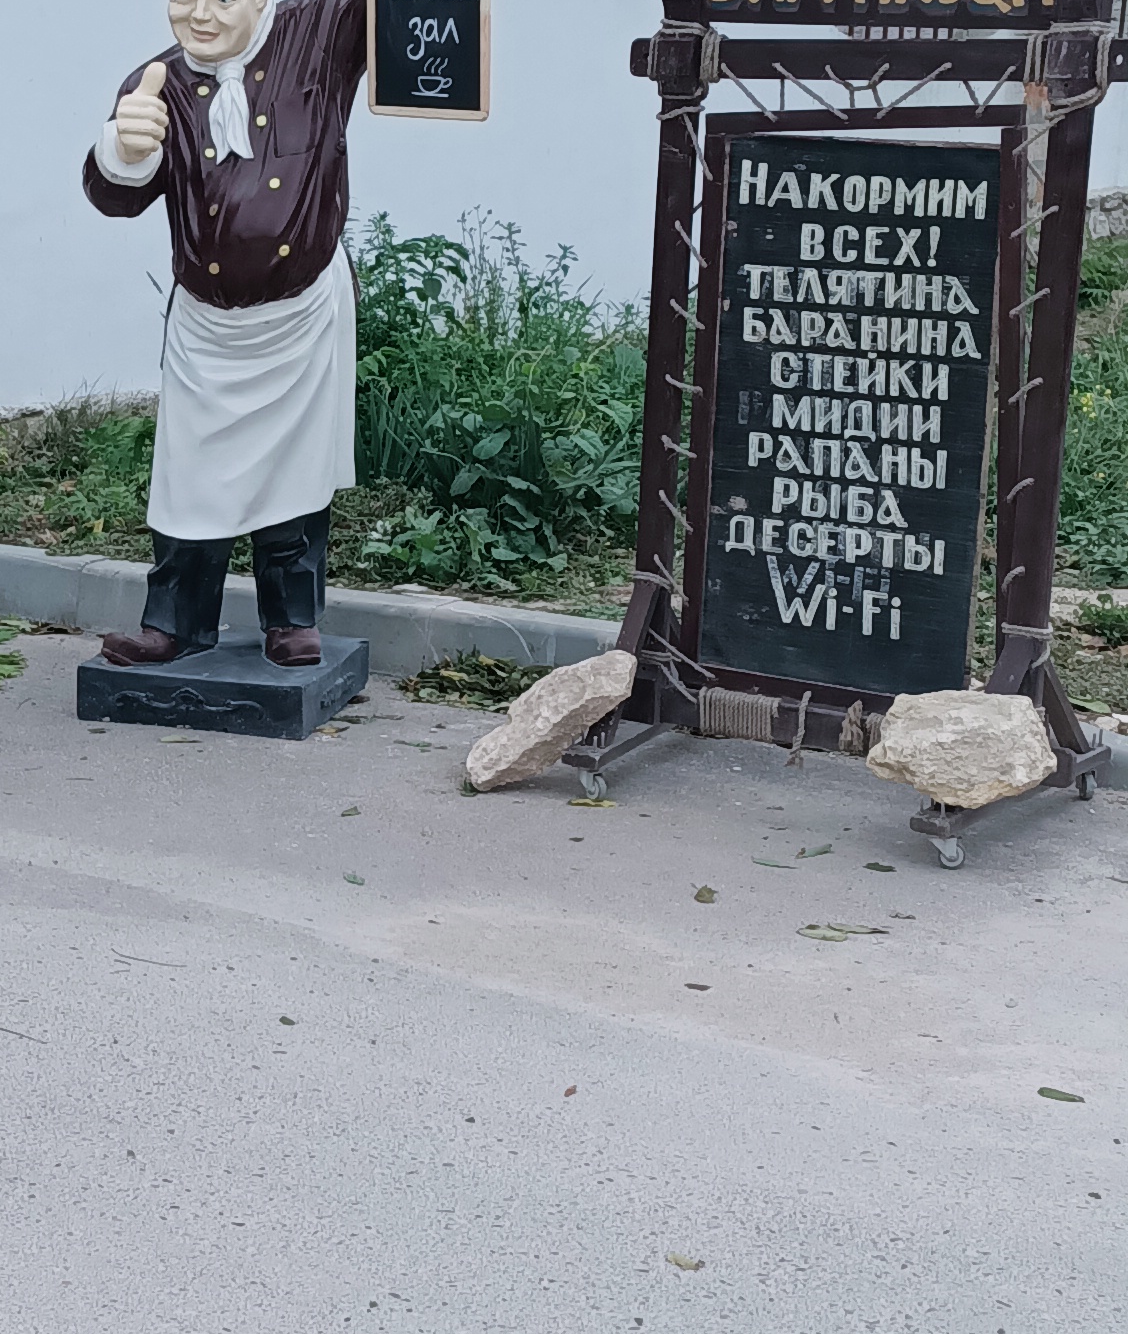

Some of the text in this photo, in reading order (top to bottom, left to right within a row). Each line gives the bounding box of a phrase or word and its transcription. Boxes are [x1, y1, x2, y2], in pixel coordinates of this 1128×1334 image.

[406, 16, 460, 61] зал
[800, 223, 941, 267] ВСЕХ!
[743, 264, 980, 315] ТЕЛЯТИНА
[743, 307, 982, 360] БАРАНИНА
[770, 351, 950, 401] СТЕЙКИ
[772, 394, 942, 444] МИДИИ
[748, 432, 948, 490] РАПАНЫ
[771, 477, 908, 528] РЫБА
[725, 515, 945, 575] ДЕСЕРТЫ
[774, 579, 902, 640] Wi-Fi
